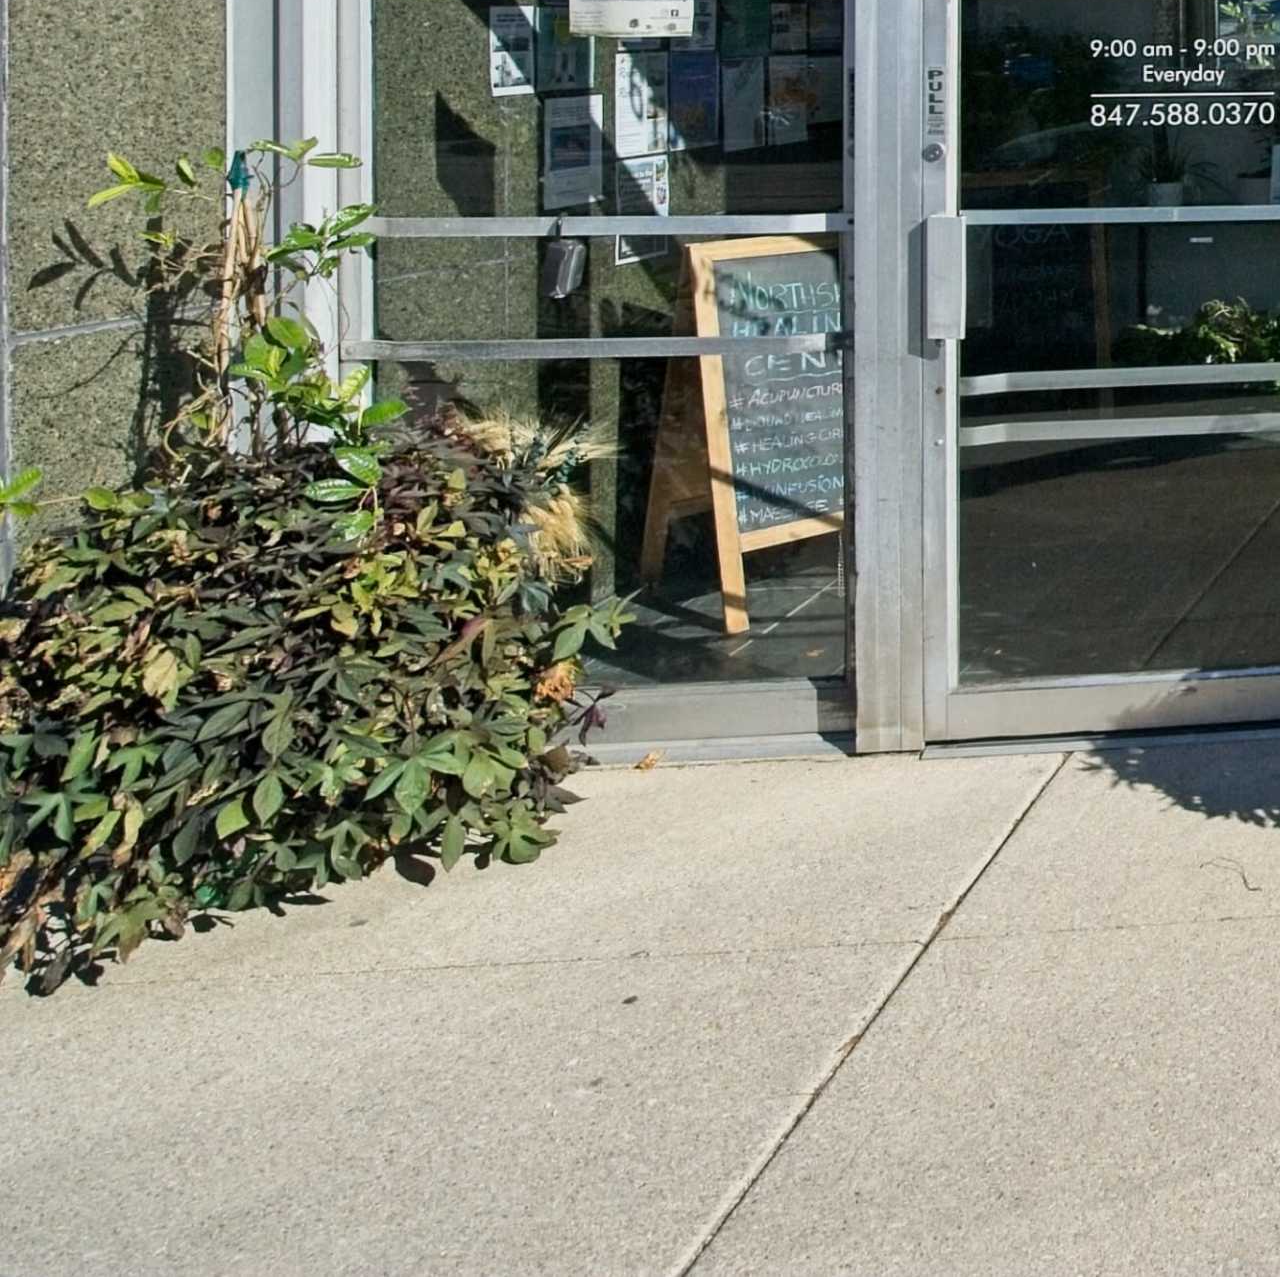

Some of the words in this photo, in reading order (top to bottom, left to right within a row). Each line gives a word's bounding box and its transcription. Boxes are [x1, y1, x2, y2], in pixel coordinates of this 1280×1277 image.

[1090, 39, 1137, 57] 9:00
[1143, 42, 1173, 57] am
[1194, 39, 1240, 57] 9:00
[1246, 42, 1275, 60] pm
[1143, 64, 1225, 86] Everyday
[928, 70, 944, 115] PULL
[1090, 102, 1276, 127] 847.588.0370
